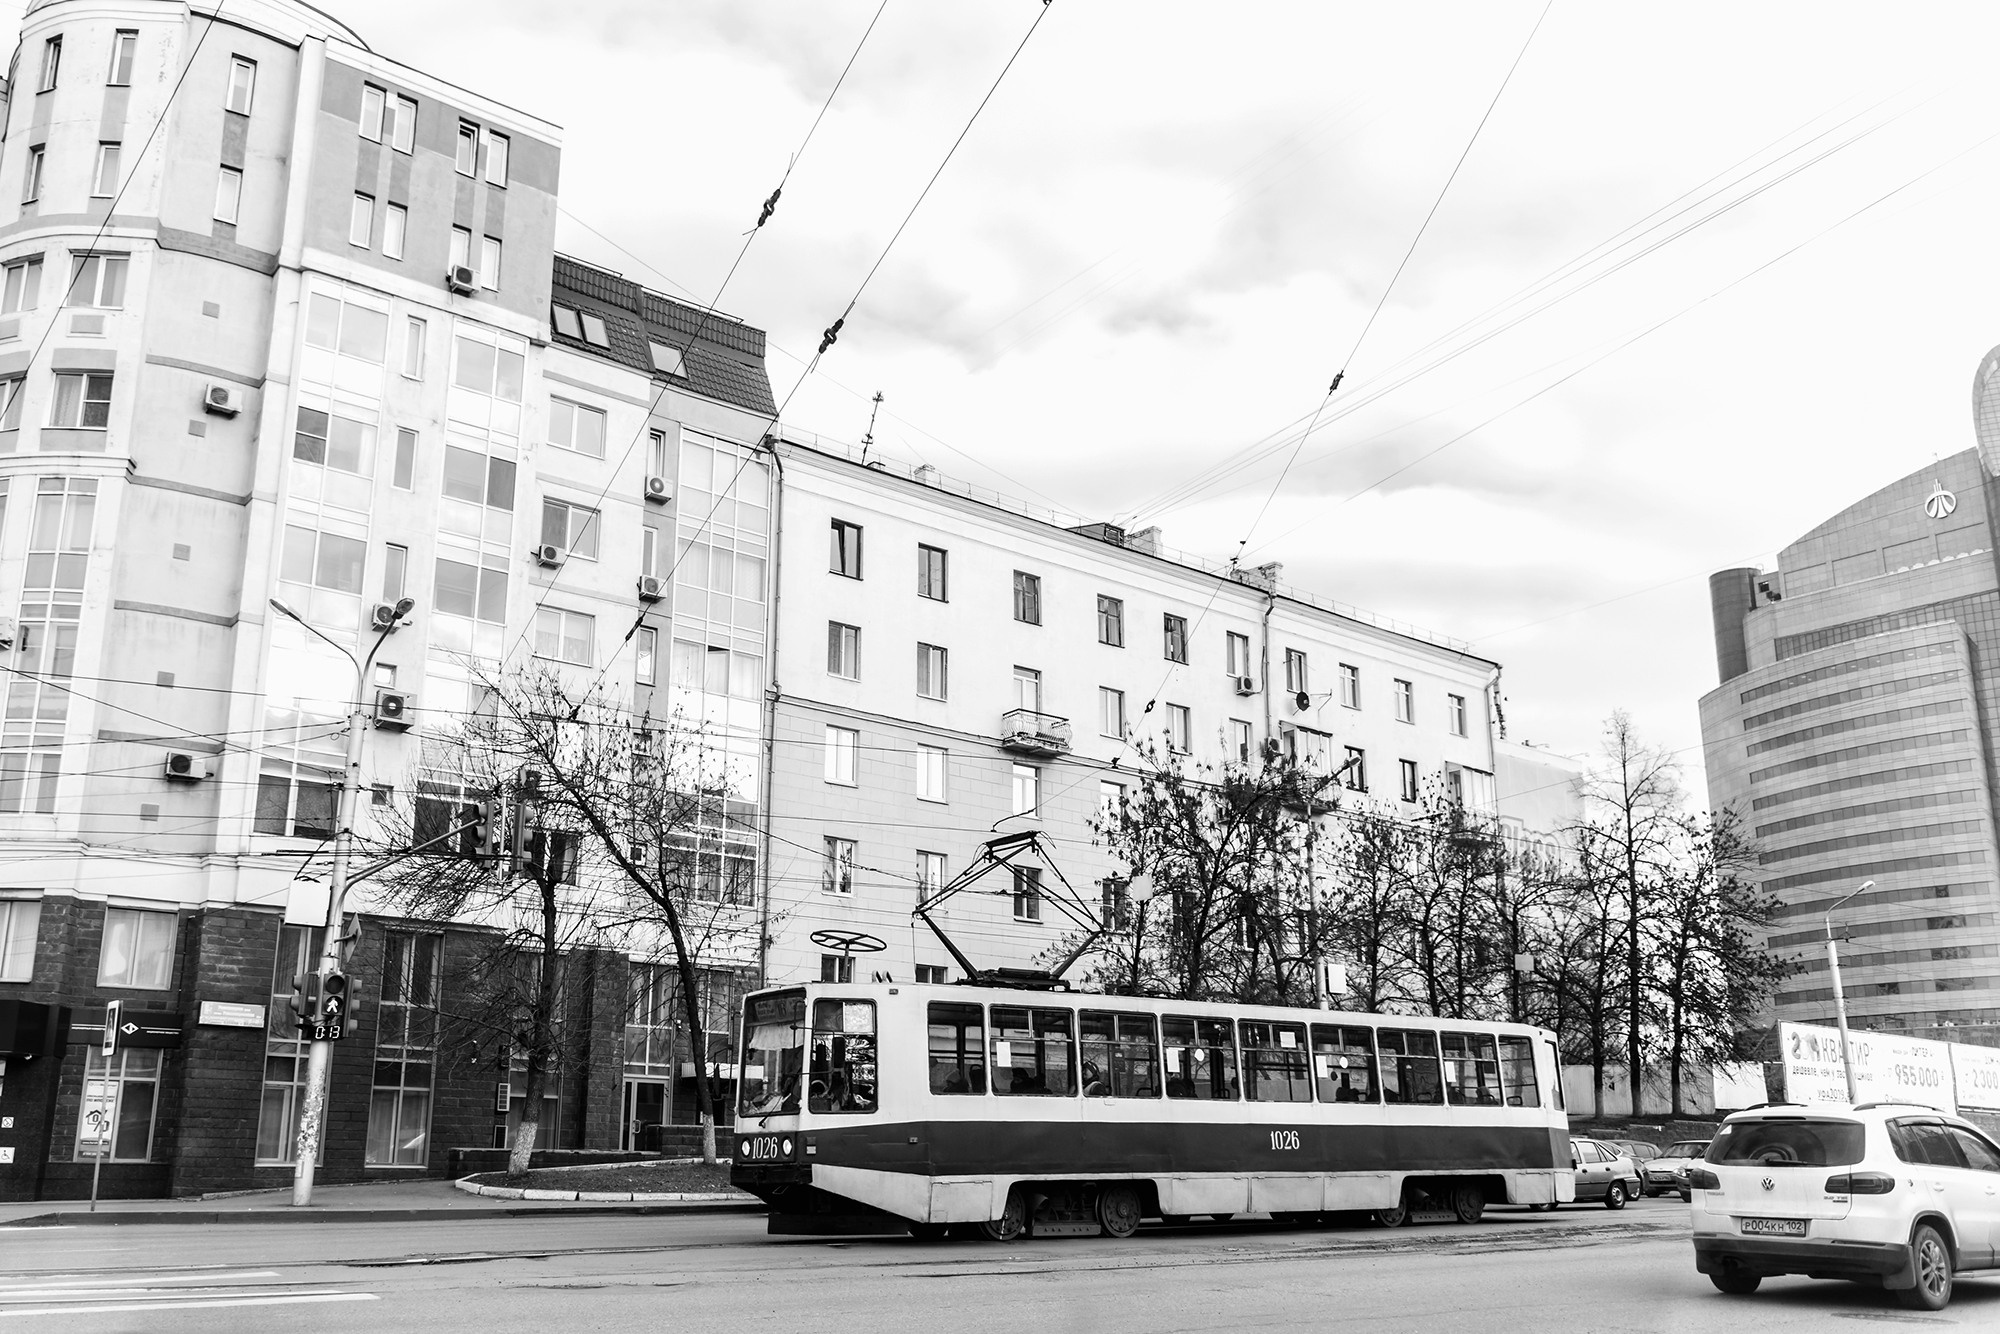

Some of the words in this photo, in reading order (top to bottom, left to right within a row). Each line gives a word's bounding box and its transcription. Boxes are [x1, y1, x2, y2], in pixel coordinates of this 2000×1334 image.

[1821, 1037, 1870, 1066] КВАТИР
[752, 1136, 778, 1159] 1026
[1270, 1130, 1300, 1150] 1026
[1786, 1220, 1803, 1231] 102
